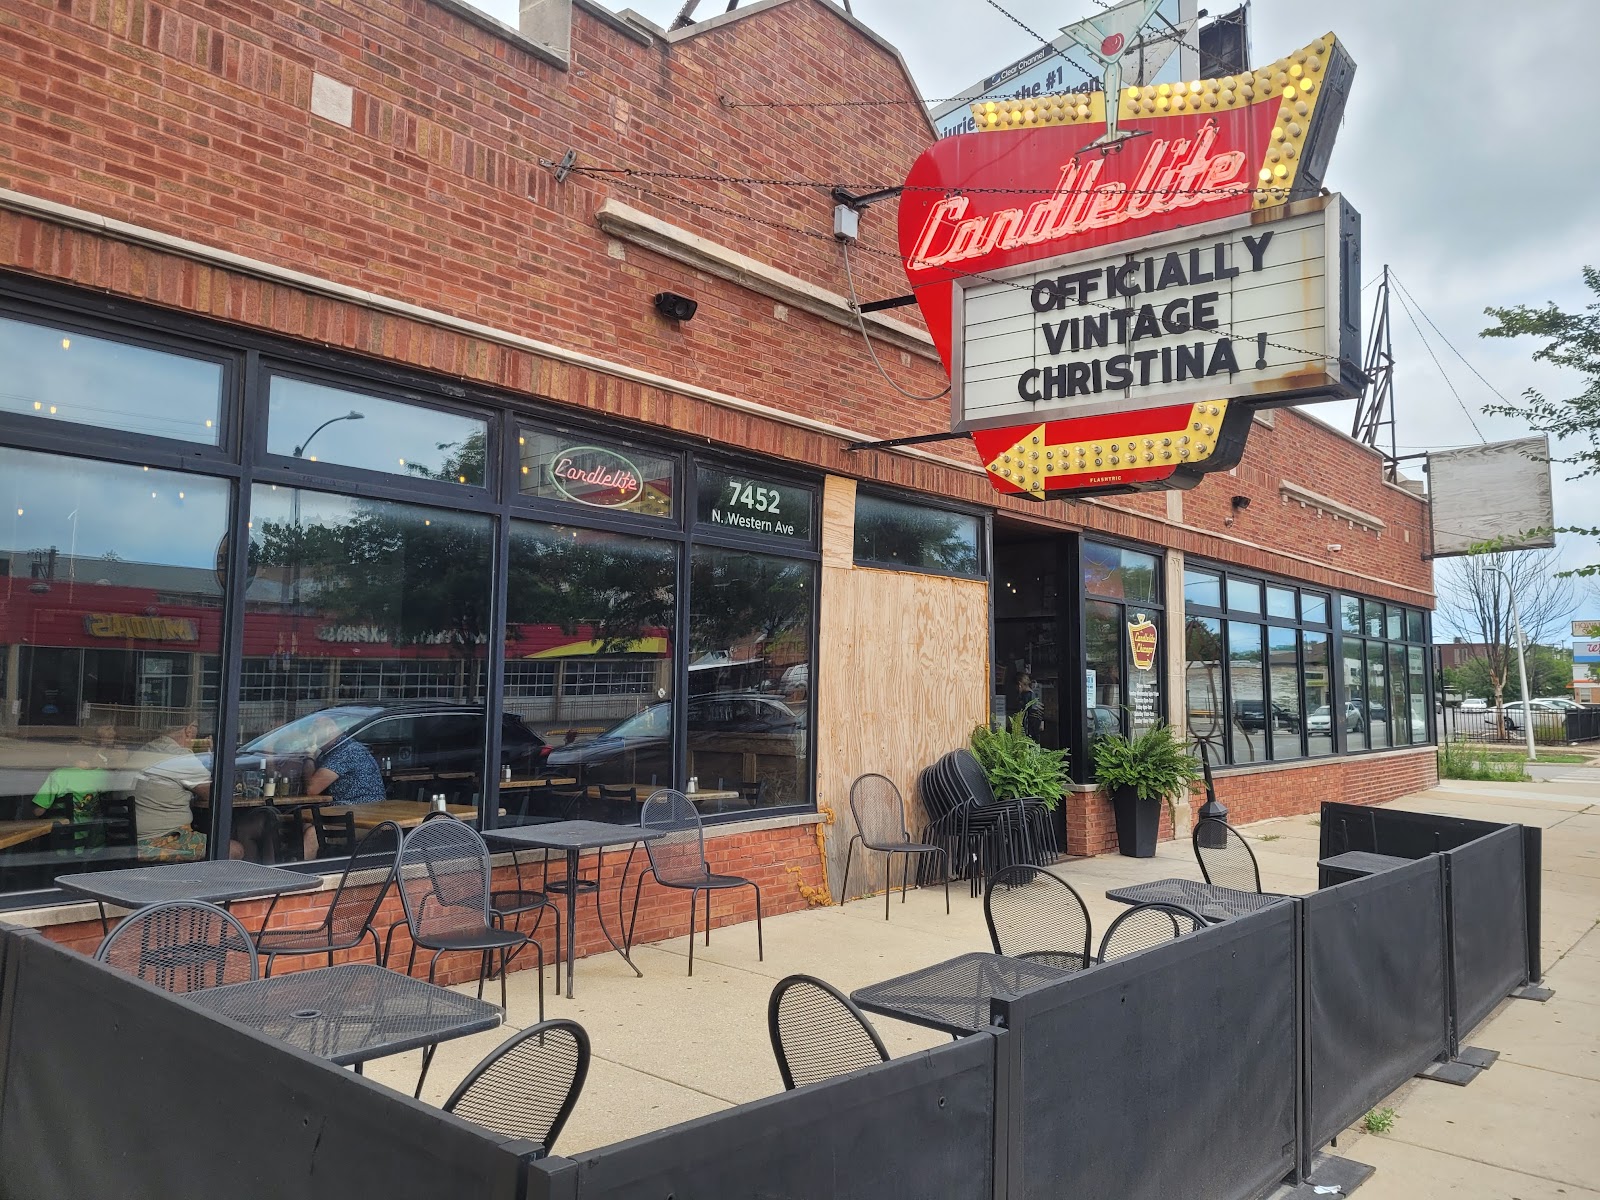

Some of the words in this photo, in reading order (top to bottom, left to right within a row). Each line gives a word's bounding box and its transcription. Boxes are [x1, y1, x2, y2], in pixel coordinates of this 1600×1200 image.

[1001, 66, 1018, 79] Clear
[1018, 49, 1045, 70] Channel
[1015, 81, 1041, 99] the
[1046, 66, 1063, 91] #1
[907, 117, 1250, 270] Candlelite
[1031, 231, 1274, 313] OFFICIALLY
[1042, 292, 1220, 355] VINTAGE
[1018, 338, 1240, 402] CHRISTINA
[555, 458, 637, 491] Candlelite
[729, 481, 780, 514] 7452
[711, 508, 724, 524] N.
[727, 511, 772, 532] Western
[775, 520, 794, 535] Ave
